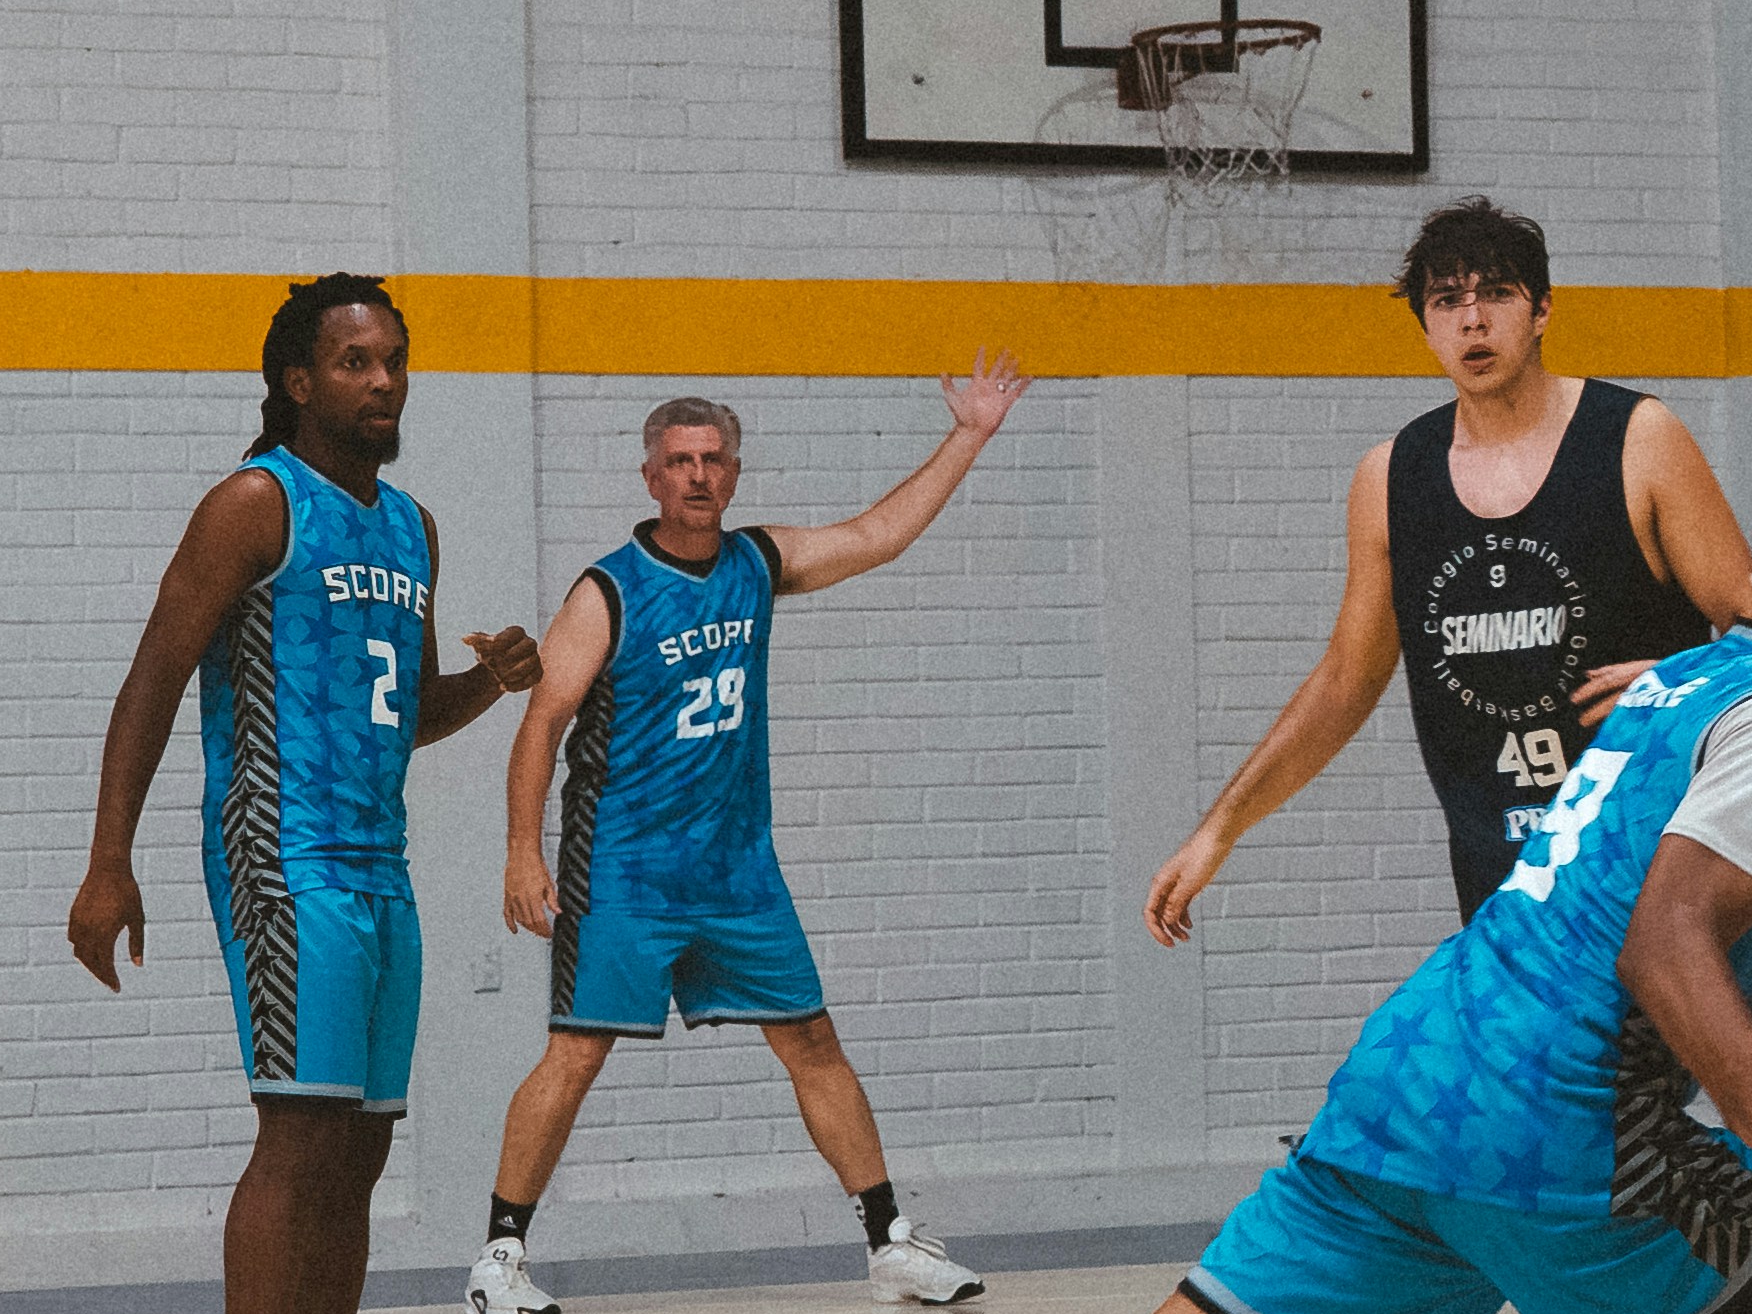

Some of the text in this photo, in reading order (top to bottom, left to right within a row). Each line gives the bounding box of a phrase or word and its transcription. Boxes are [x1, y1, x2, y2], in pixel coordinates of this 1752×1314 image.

[321, 564, 429, 620] SCORE
[1424, 545, 1475, 634] Colegio
[1485, 534, 1587, 618] Seminario
[366, 638, 400, 729] 2
[676, 666, 746, 740] 29
[1497, 729, 1569, 788] 49
